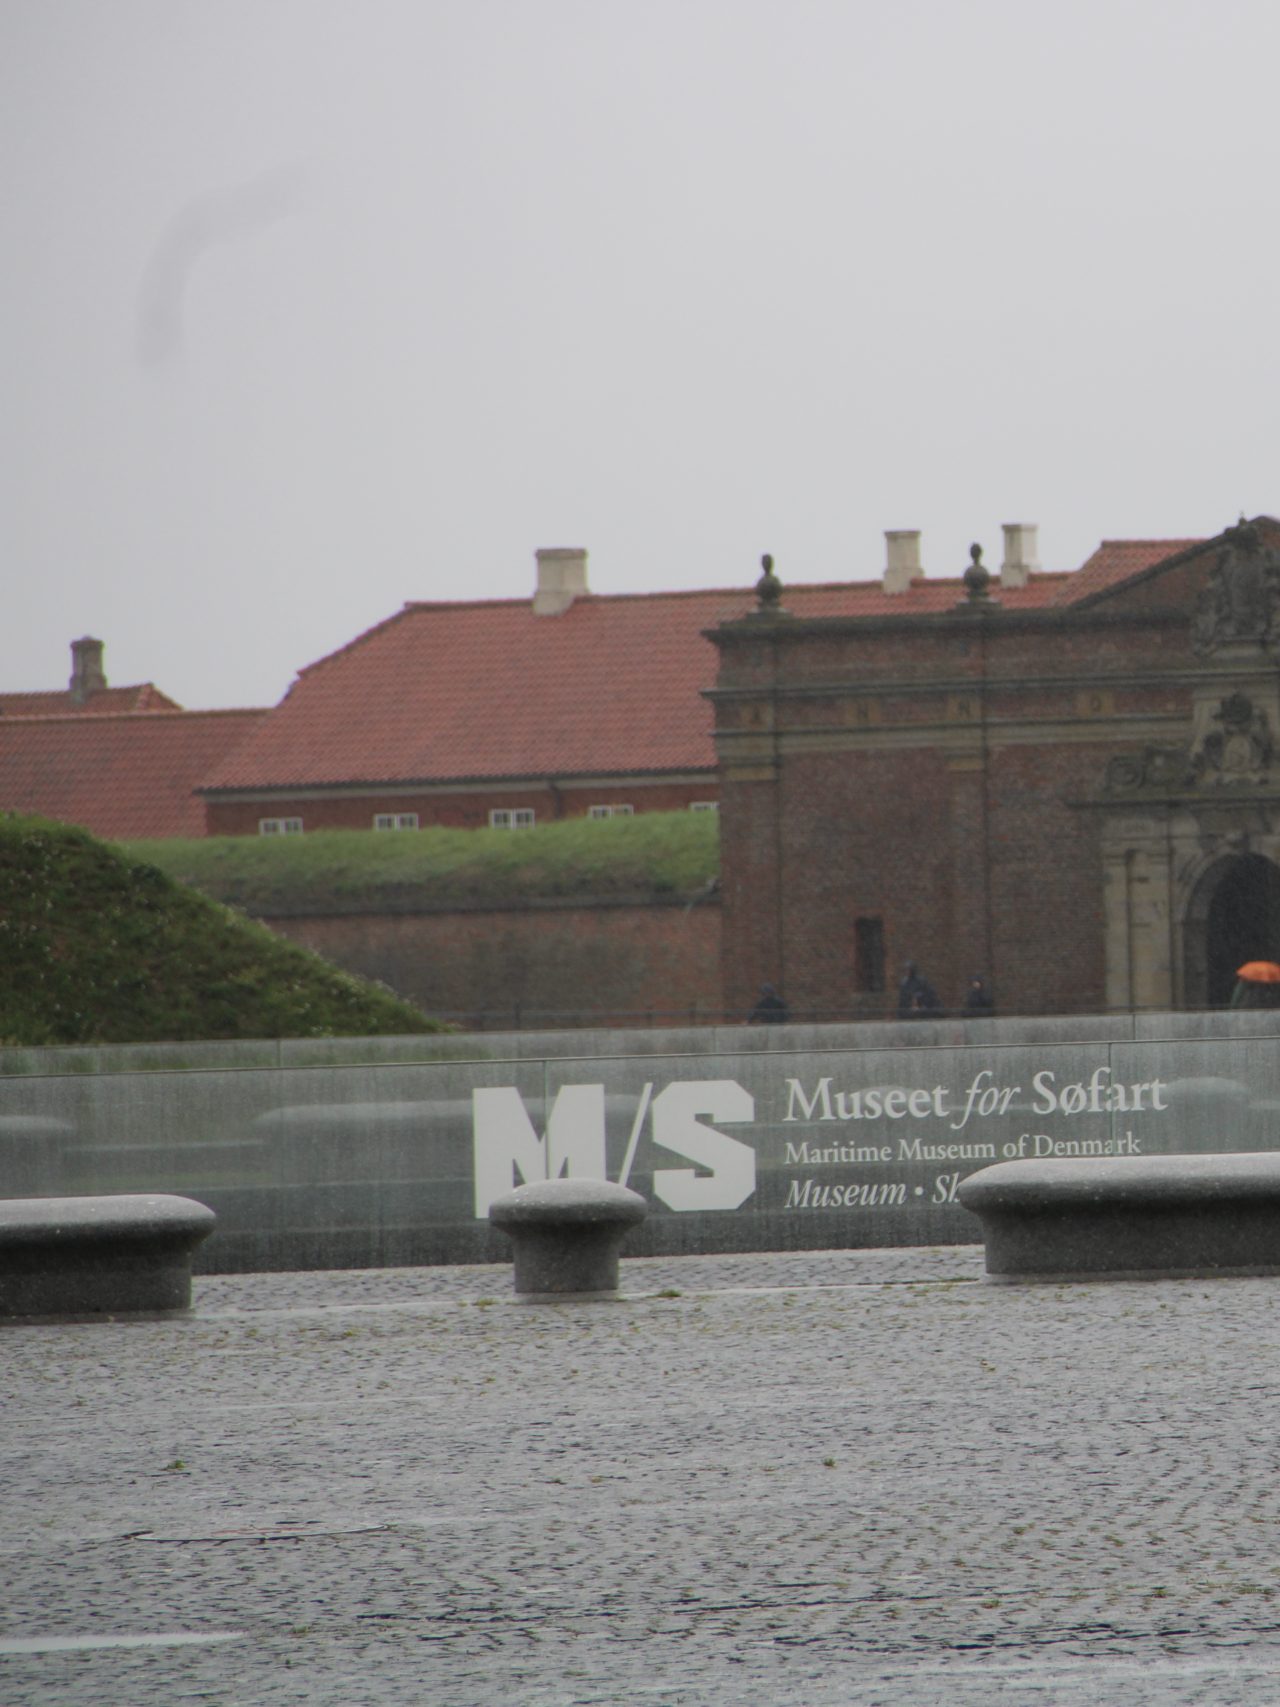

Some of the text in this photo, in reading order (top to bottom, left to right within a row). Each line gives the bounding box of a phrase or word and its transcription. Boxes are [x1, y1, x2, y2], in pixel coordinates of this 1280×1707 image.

[782, 1066, 1168, 1130] Museet for Søfart
[472, 1079, 756, 1219] M/S
[784, 1131, 1141, 1165] Maritime Museum of Denmark
[784, 1179, 907, 1208] Museum
